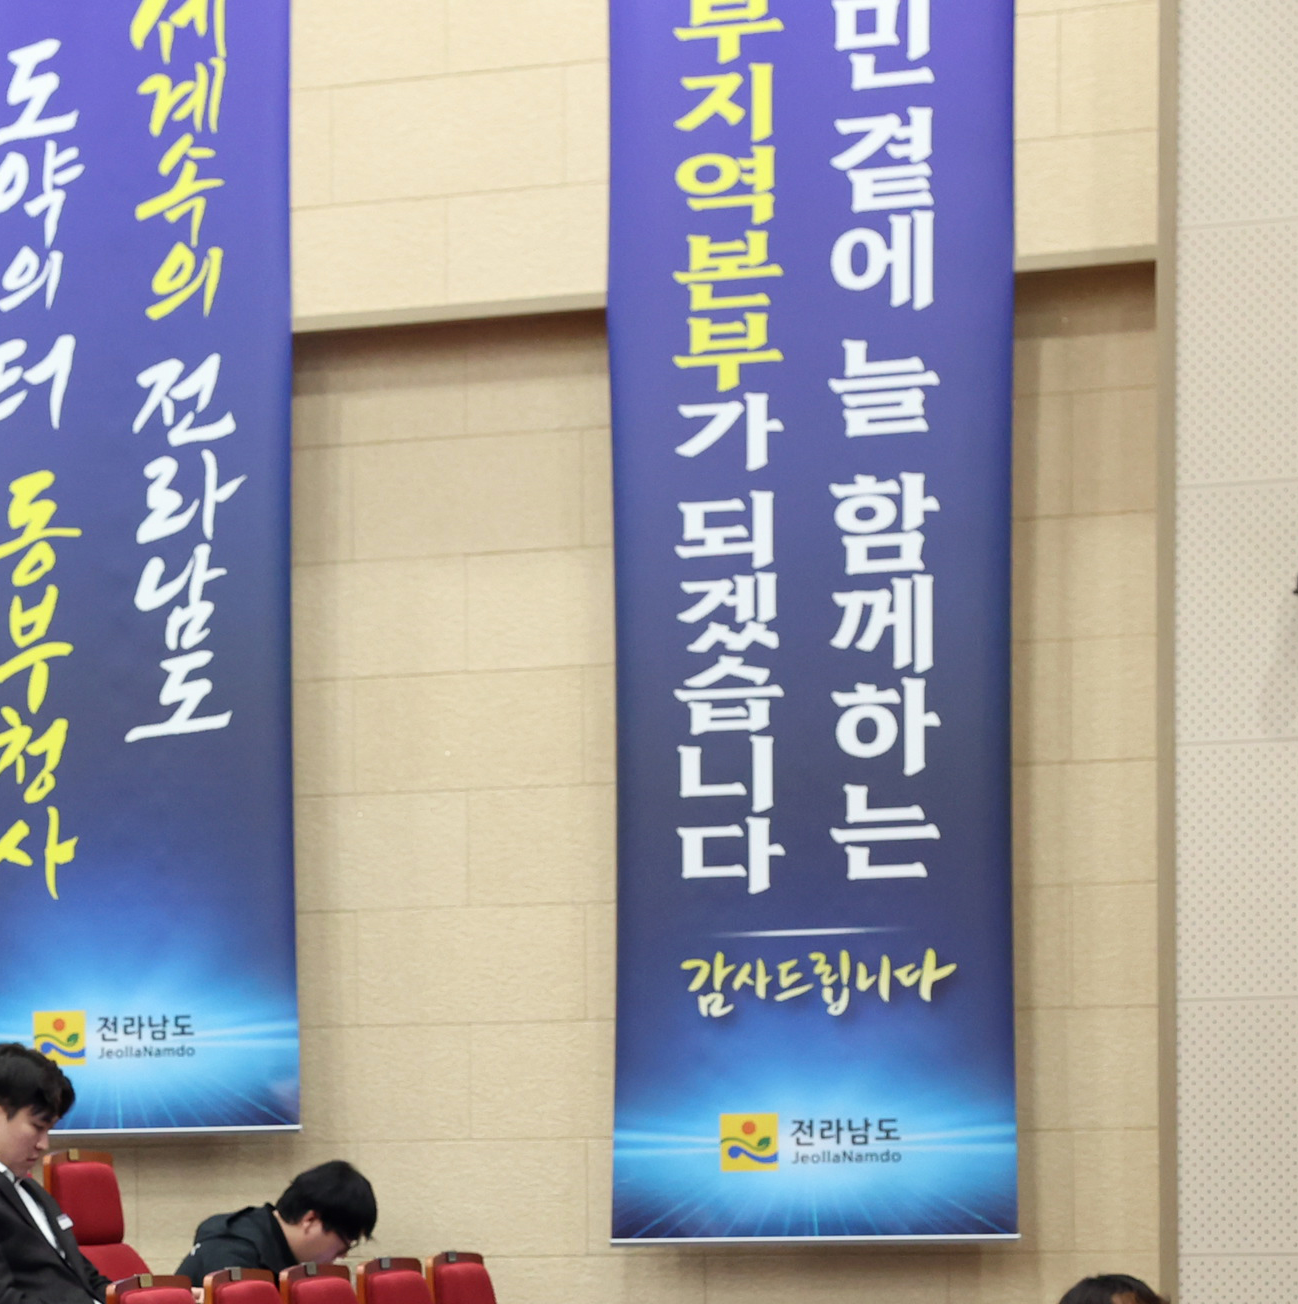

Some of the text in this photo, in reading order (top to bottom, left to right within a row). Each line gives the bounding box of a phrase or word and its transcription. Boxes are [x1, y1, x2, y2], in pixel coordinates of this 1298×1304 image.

[828, 339, 940, 438] 늘
[124, 353, 247, 743] 전라남도
[674, 490, 786, 894] 되겠습니다
[829, 472, 941, 880] 함께하는
[680, 948, 957, 1017] 감사드립니다
[96, 1014, 196, 1042] 전라남도
[97, 1045, 196, 1060] JeollaNamdo
[790, 1117, 902, 1146] 전라남도
[791, 1149, 903, 1165] JeollaNamdo
